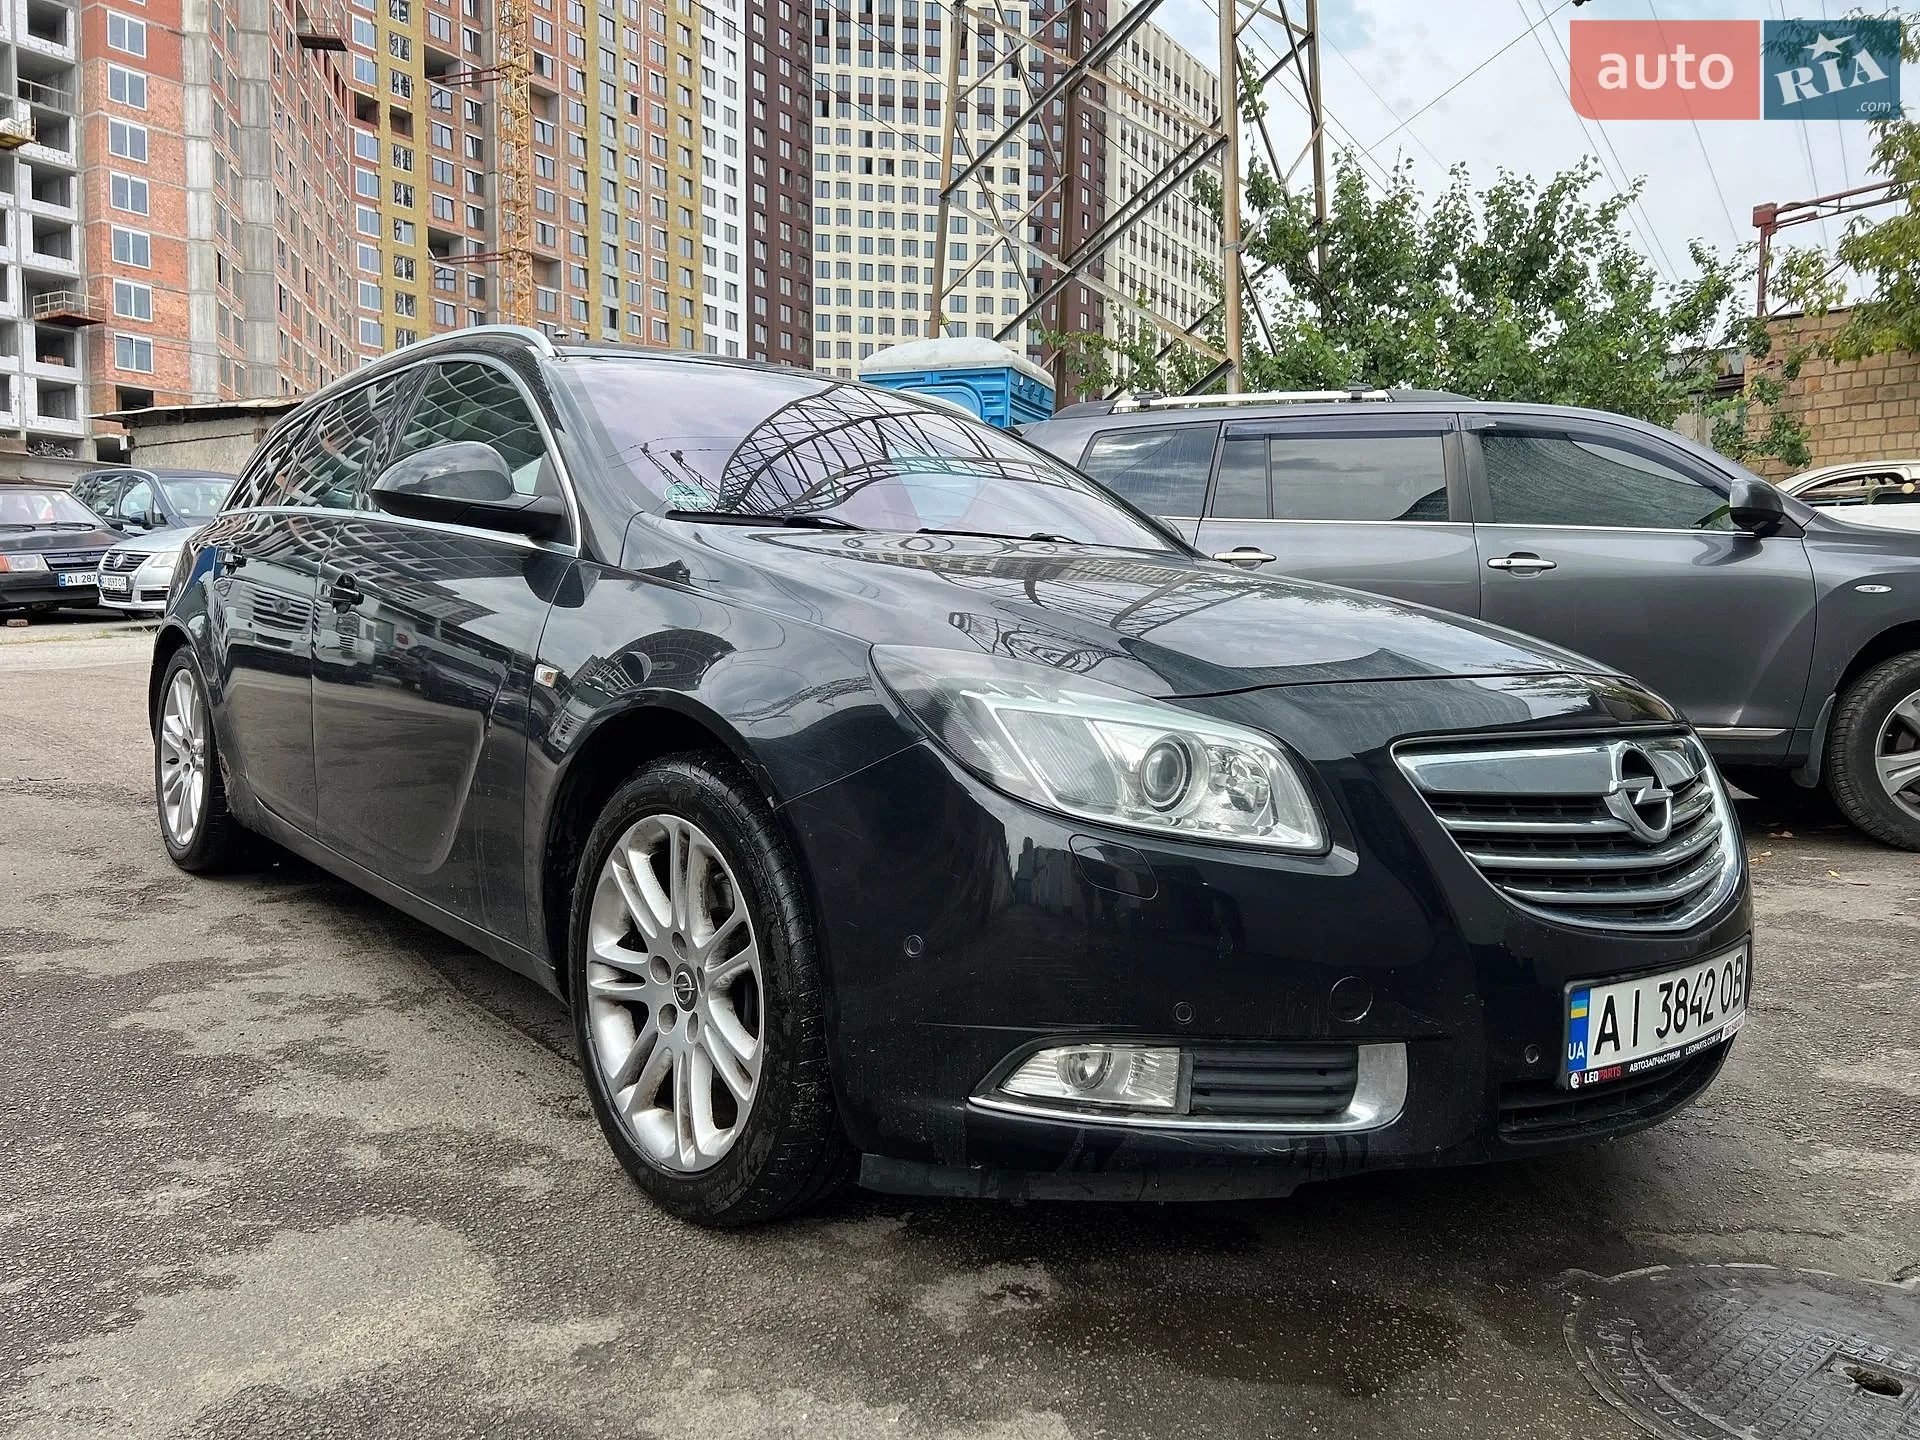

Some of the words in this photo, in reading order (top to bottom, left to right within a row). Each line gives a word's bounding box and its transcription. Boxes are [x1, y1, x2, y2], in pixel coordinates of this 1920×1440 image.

[1593, 989, 1640, 1055] AI
[1655, 967, 1716, 1039] 3842
[1720, 955, 1744, 1014] OB
[1568, 1040, 1585, 1060] UA
[1629, 1050, 1681, 1073] АВТОЗАПЧАСТИНИ
[1584, 1066, 1622, 1083] LEOPARTS
